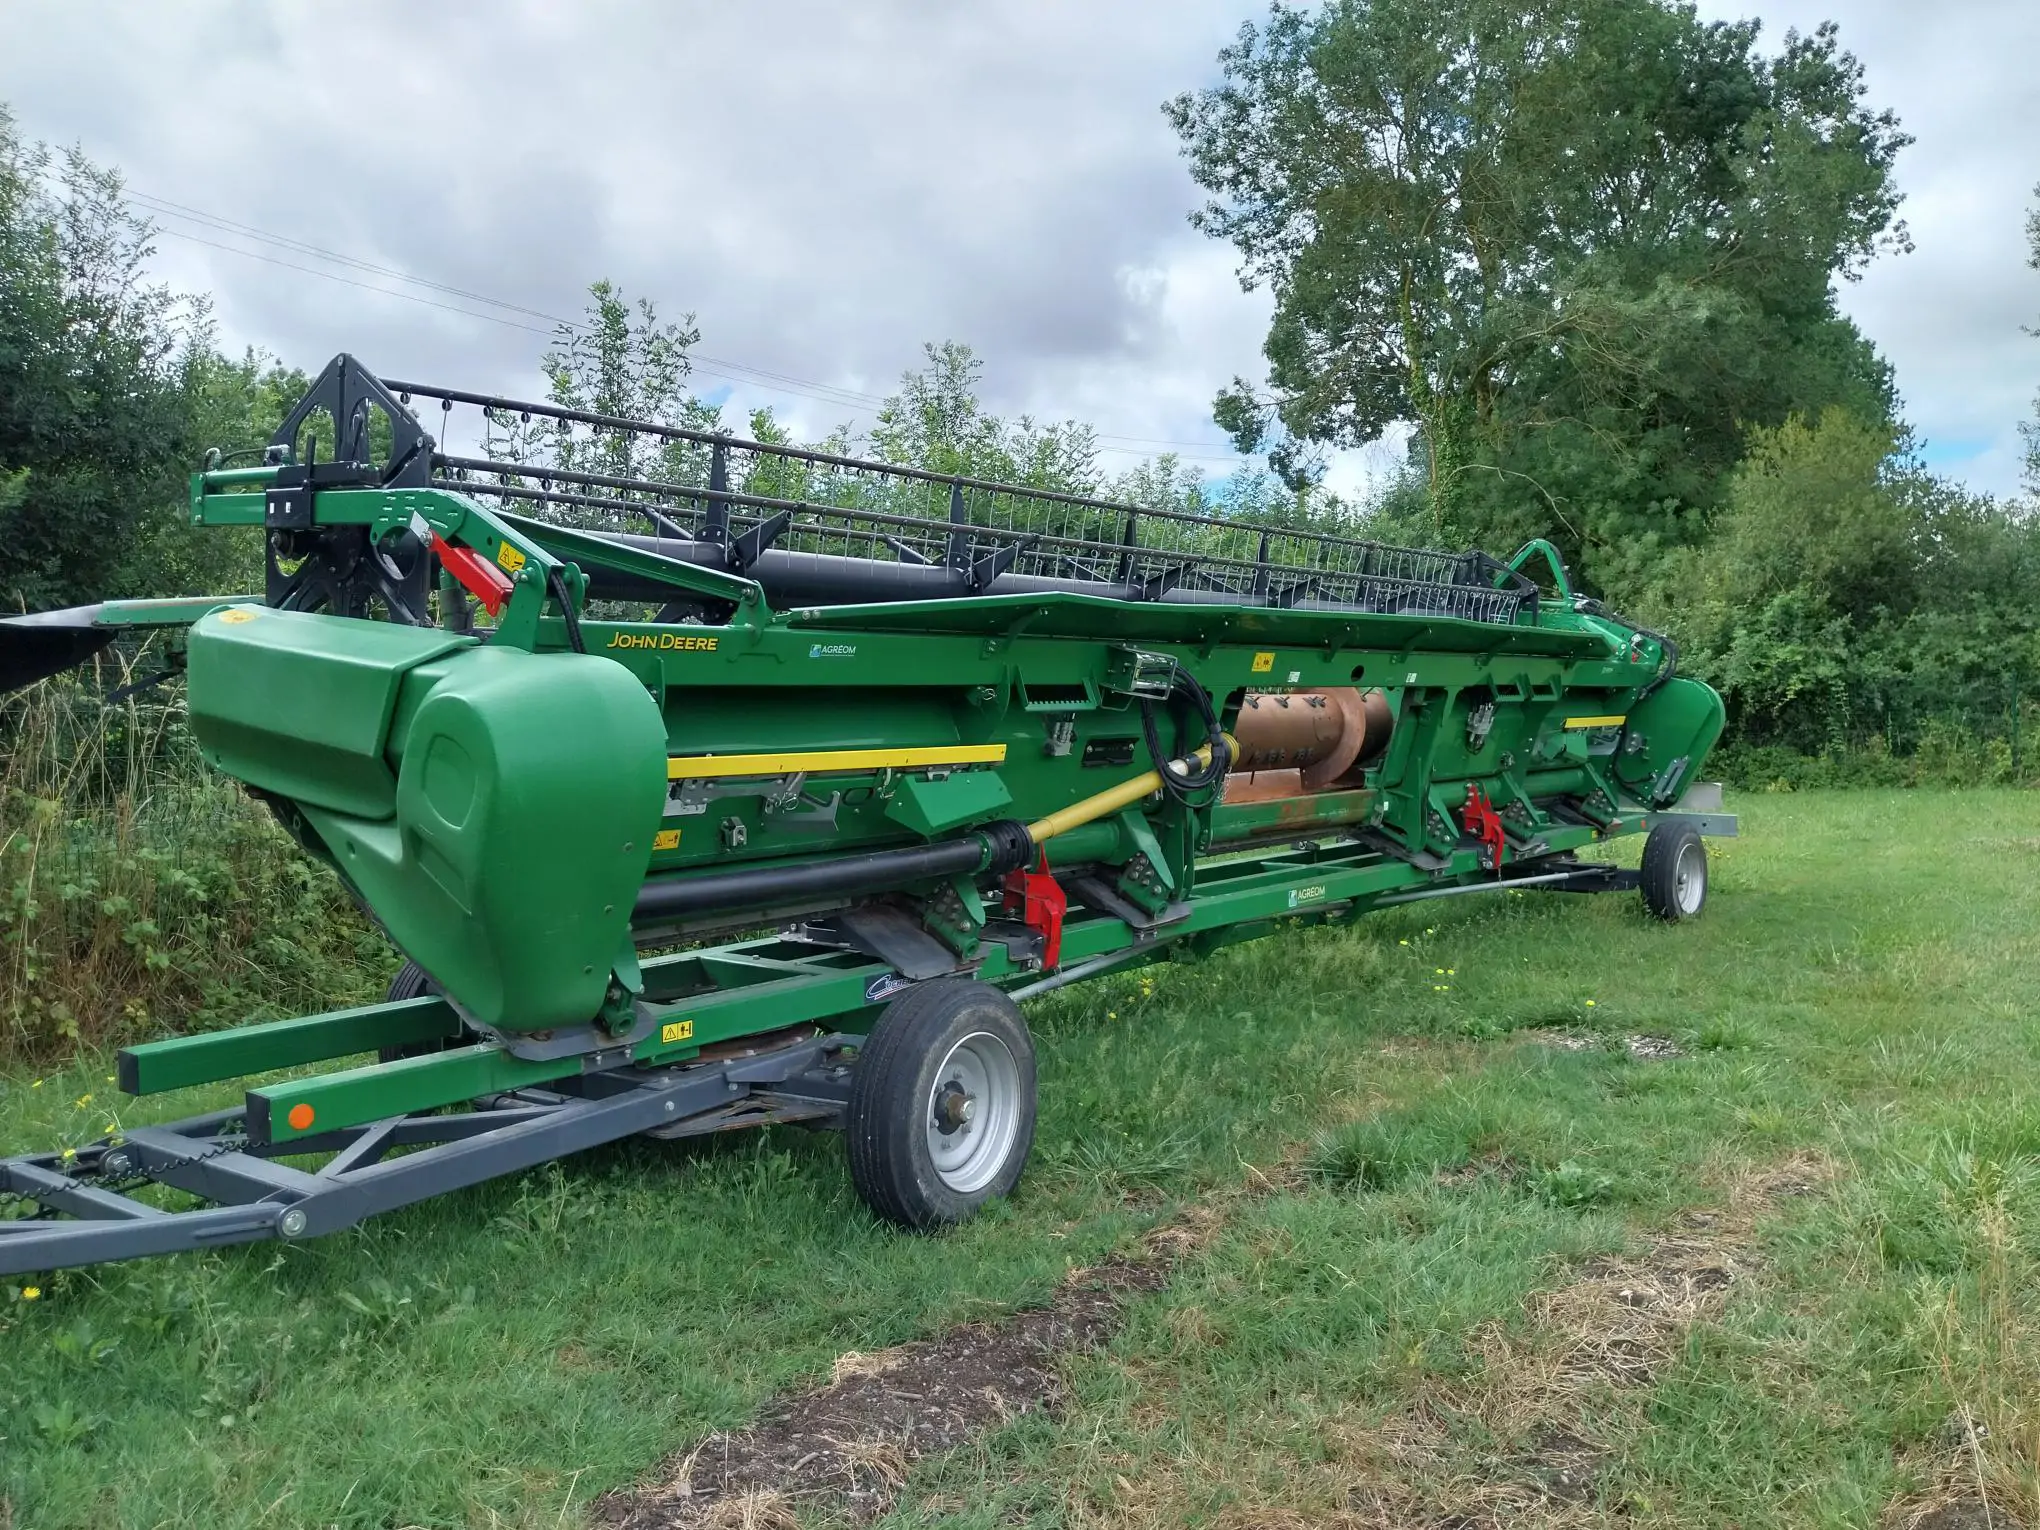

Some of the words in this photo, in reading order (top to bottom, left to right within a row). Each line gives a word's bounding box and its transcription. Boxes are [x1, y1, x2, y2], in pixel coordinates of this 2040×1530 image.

[607, 631, 658, 649] JOHN
[660, 633, 718, 651] DEERE
[821, 644, 857, 654] AGRÉOM
